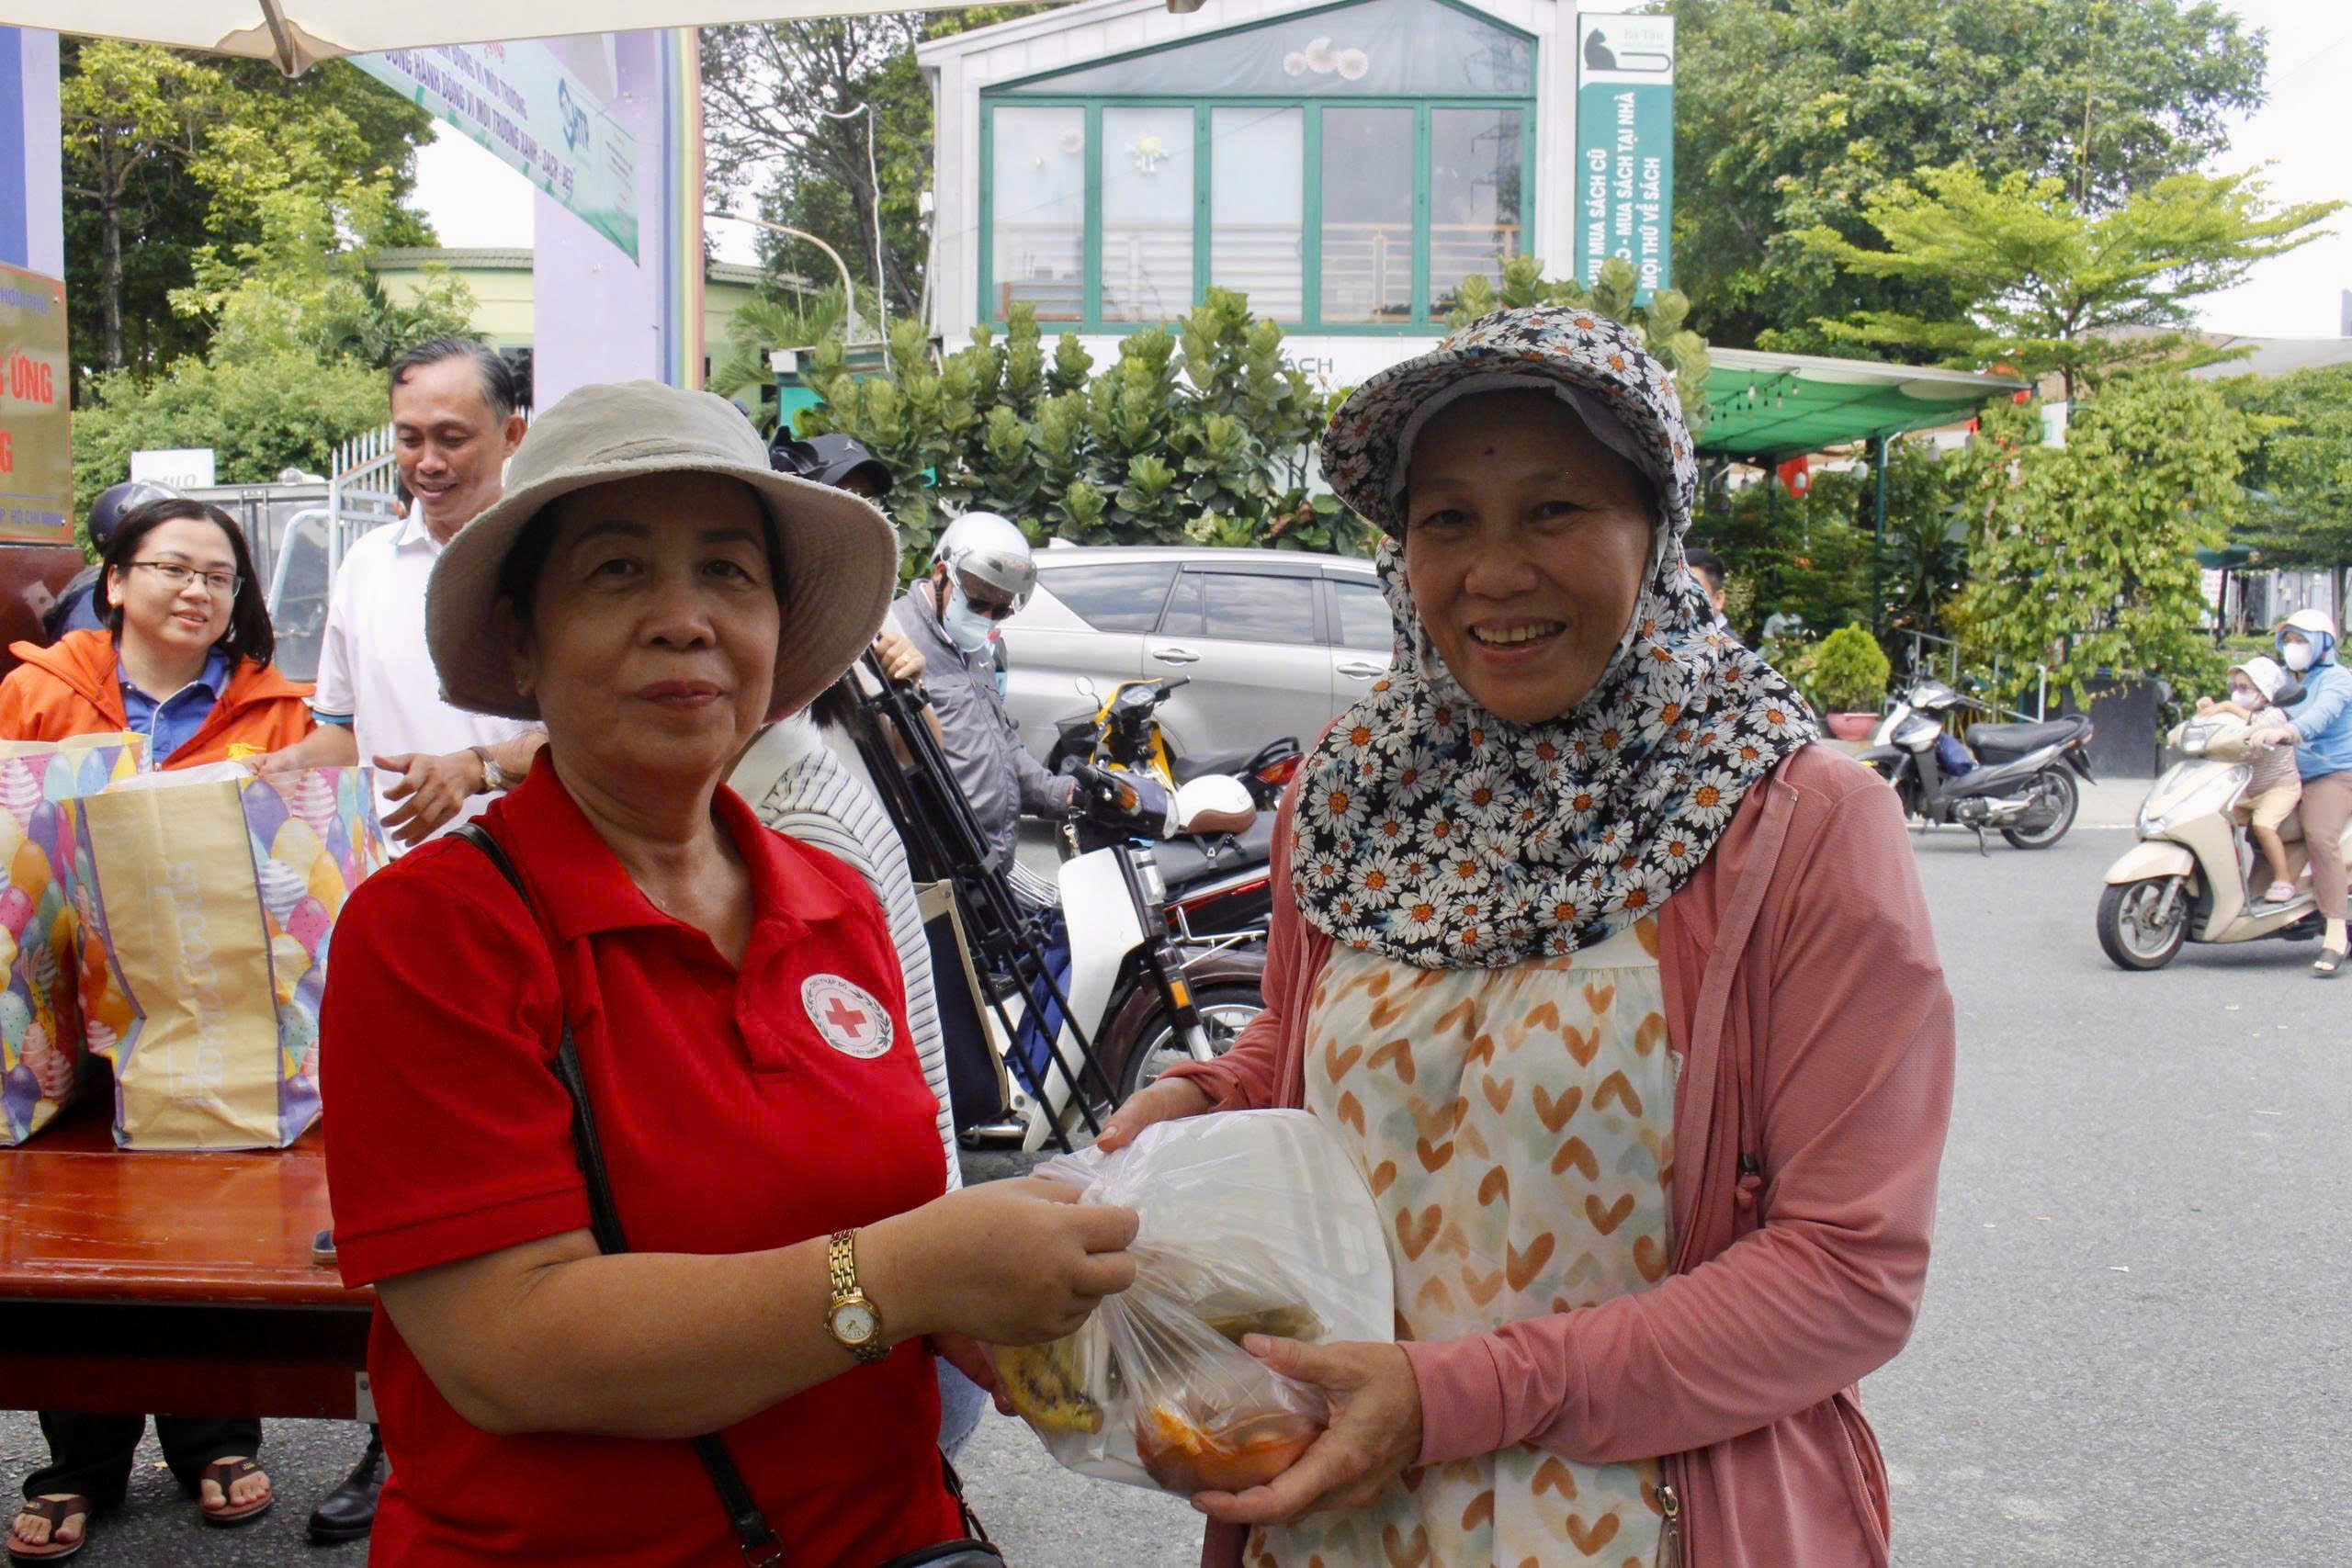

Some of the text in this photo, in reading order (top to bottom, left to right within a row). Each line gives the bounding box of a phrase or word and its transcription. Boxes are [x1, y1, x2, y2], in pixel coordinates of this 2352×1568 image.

[1613, 92, 1634, 125] NHÀ
[1617, 129, 1639, 152] TẠI
[1587, 148, 1607, 172] CŨ
[1612, 155, 1634, 199] SÁCH
[1639, 157, 1661, 200] SÁCH
[1586, 175, 1607, 218] SÁCH
[1635, 203, 1660, 222] VỀ
[1616, 202, 1634, 236] MUA
[1588, 221, 1606, 255] MUA
[1638, 224, 1659, 254] THỨ
[1641, 257, 1663, 289] MỌI
[10, 347, 53, 404] ỨNG
[1281, 348, 1333, 374] ÁCH
